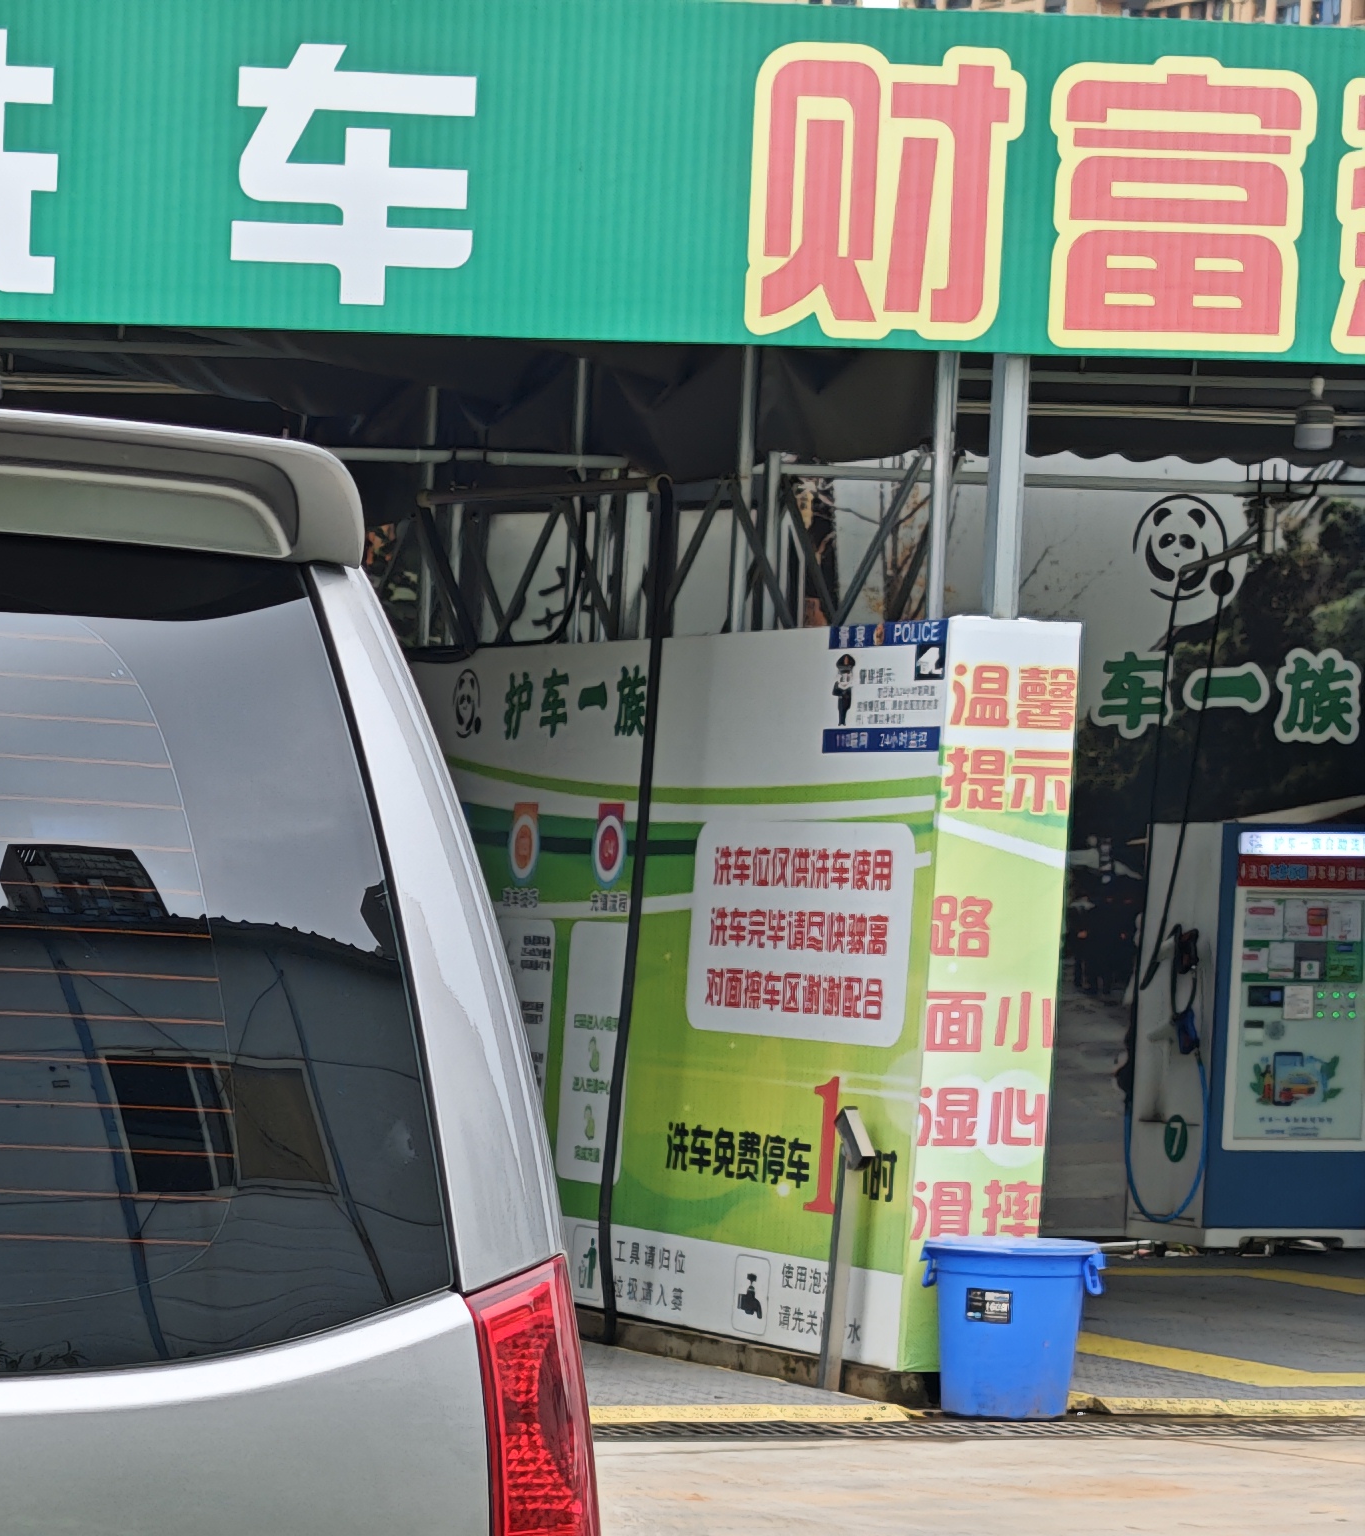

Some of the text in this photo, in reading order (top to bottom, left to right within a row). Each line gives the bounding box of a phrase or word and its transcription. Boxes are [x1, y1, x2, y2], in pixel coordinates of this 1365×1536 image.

[744, 41, 1365, 354] 财富
[892, 621, 941, 643] POLICE
[503, 664, 647, 741] 护车一族
[950, 663, 1076, 731] 温馨
[1097, 651, 1355, 737] 车一族
[943, 746, 1071, 815] 提示
[712, 845, 894, 892] 洗车位仅供洗车使用
[708, 905, 890, 957] 洗车完毕请尽快驶离
[666, 1076, 898, 1215] 洗车免费停车1时
[1170, 1121, 1183, 1156] 7
[614, 1240, 686, 1275] 工具请归位
